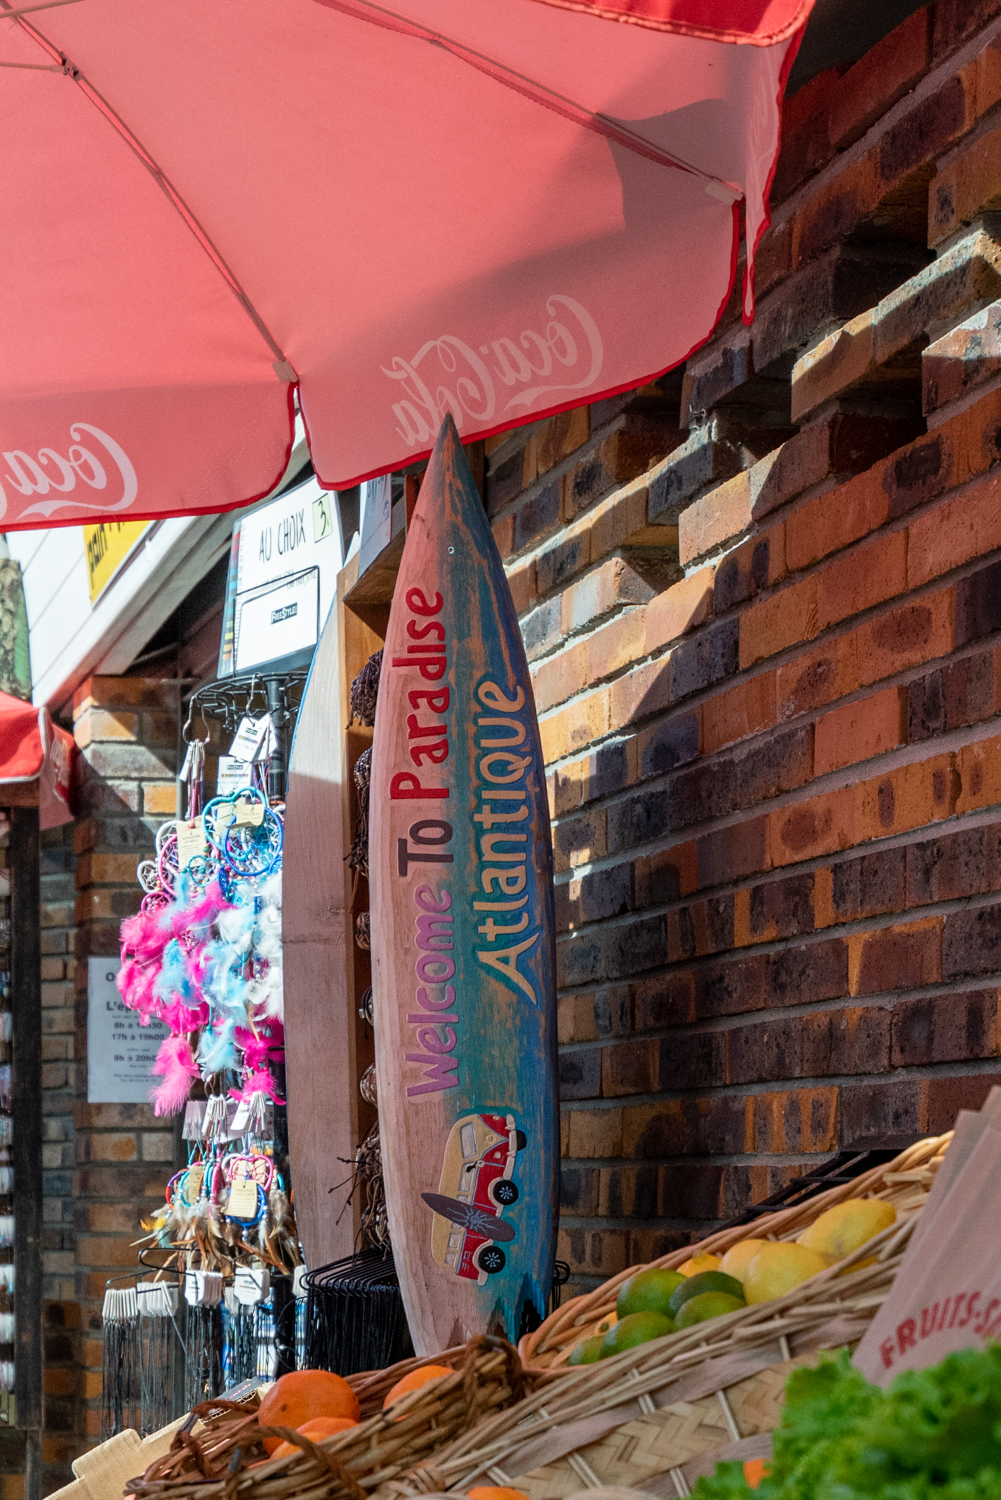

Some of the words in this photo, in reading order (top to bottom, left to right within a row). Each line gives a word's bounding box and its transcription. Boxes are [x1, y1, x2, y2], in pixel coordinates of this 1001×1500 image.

[259, 526, 274, 563] AU
[277, 508, 306, 556] CHOIX
[389, 586, 450, 801] Paradise
[398, 818, 455, 878] To
[404, 883, 460, 1097] Welcome
